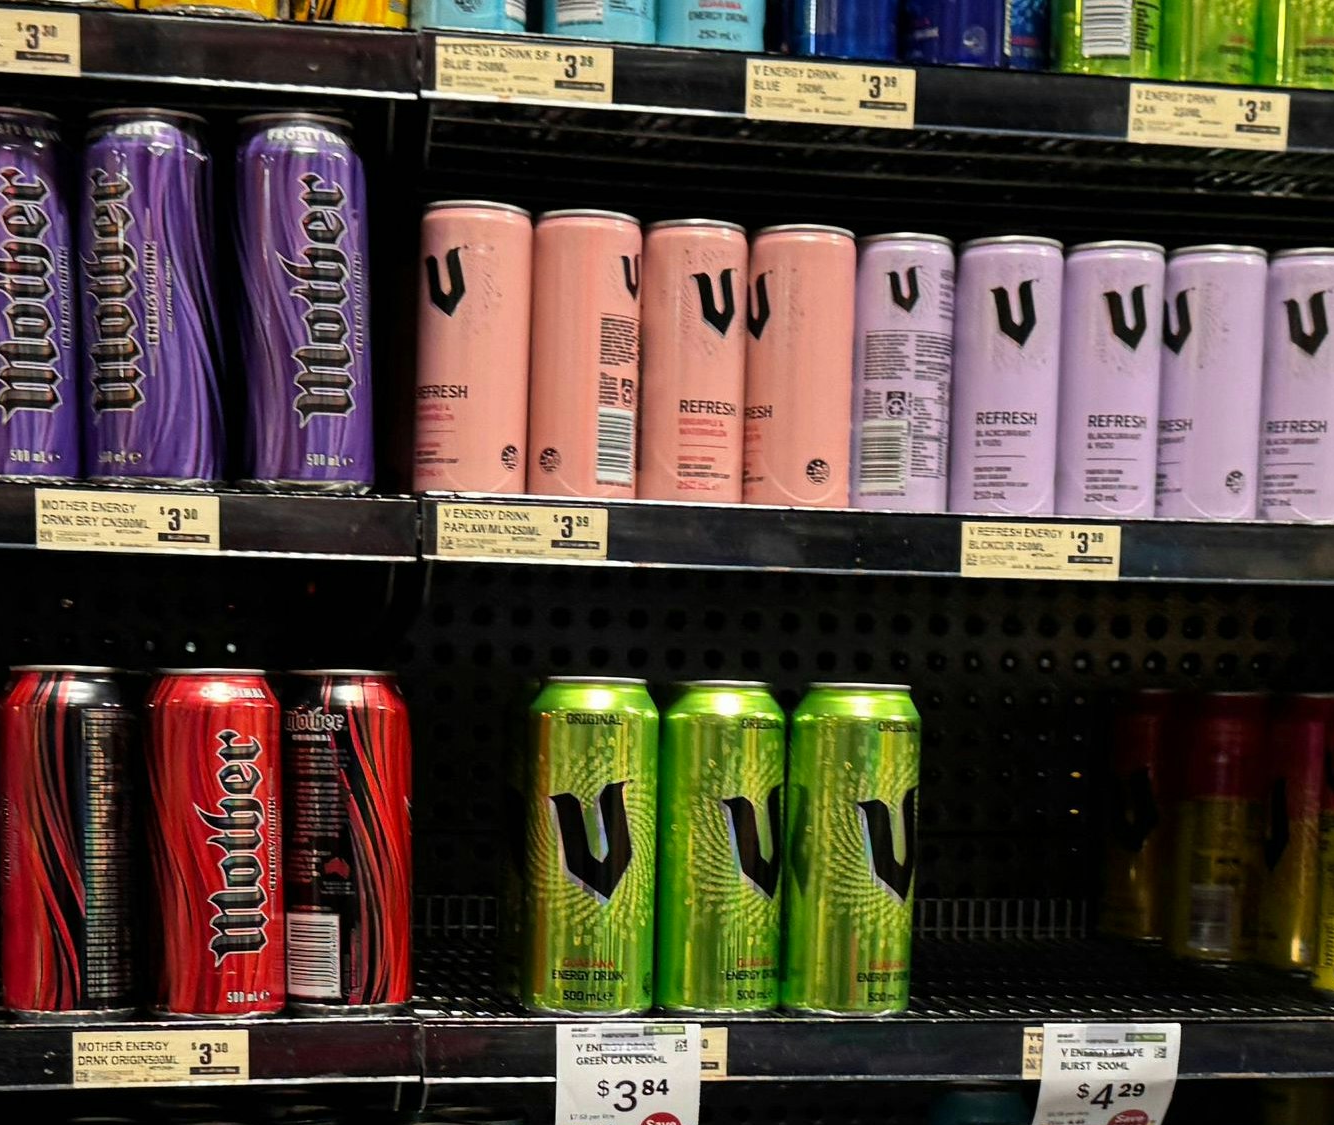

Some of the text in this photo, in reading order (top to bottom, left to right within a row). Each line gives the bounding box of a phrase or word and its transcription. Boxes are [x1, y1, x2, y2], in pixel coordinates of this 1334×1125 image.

[680, 399, 737, 417] REFRESH
[976, 411, 1037, 427] REFRESH
[1087, 414, 1147, 429] REFRESH
[42, 500, 136, 516] MOTHER ENERGY
[454, 510, 494, 521] ENERGY
[497, 511, 530, 522] DRINK
[1024, 528, 1063, 540] ENERGY
[566, 714, 623, 726] ORIGINAL
[78, 1041, 169, 1053] MOTHER ENERGY
[78, 1055, 108, 1066] DRNK
[576, 1056, 632, 1066] GREEN CAN
[1060, 1062, 1091, 1070] BURST
